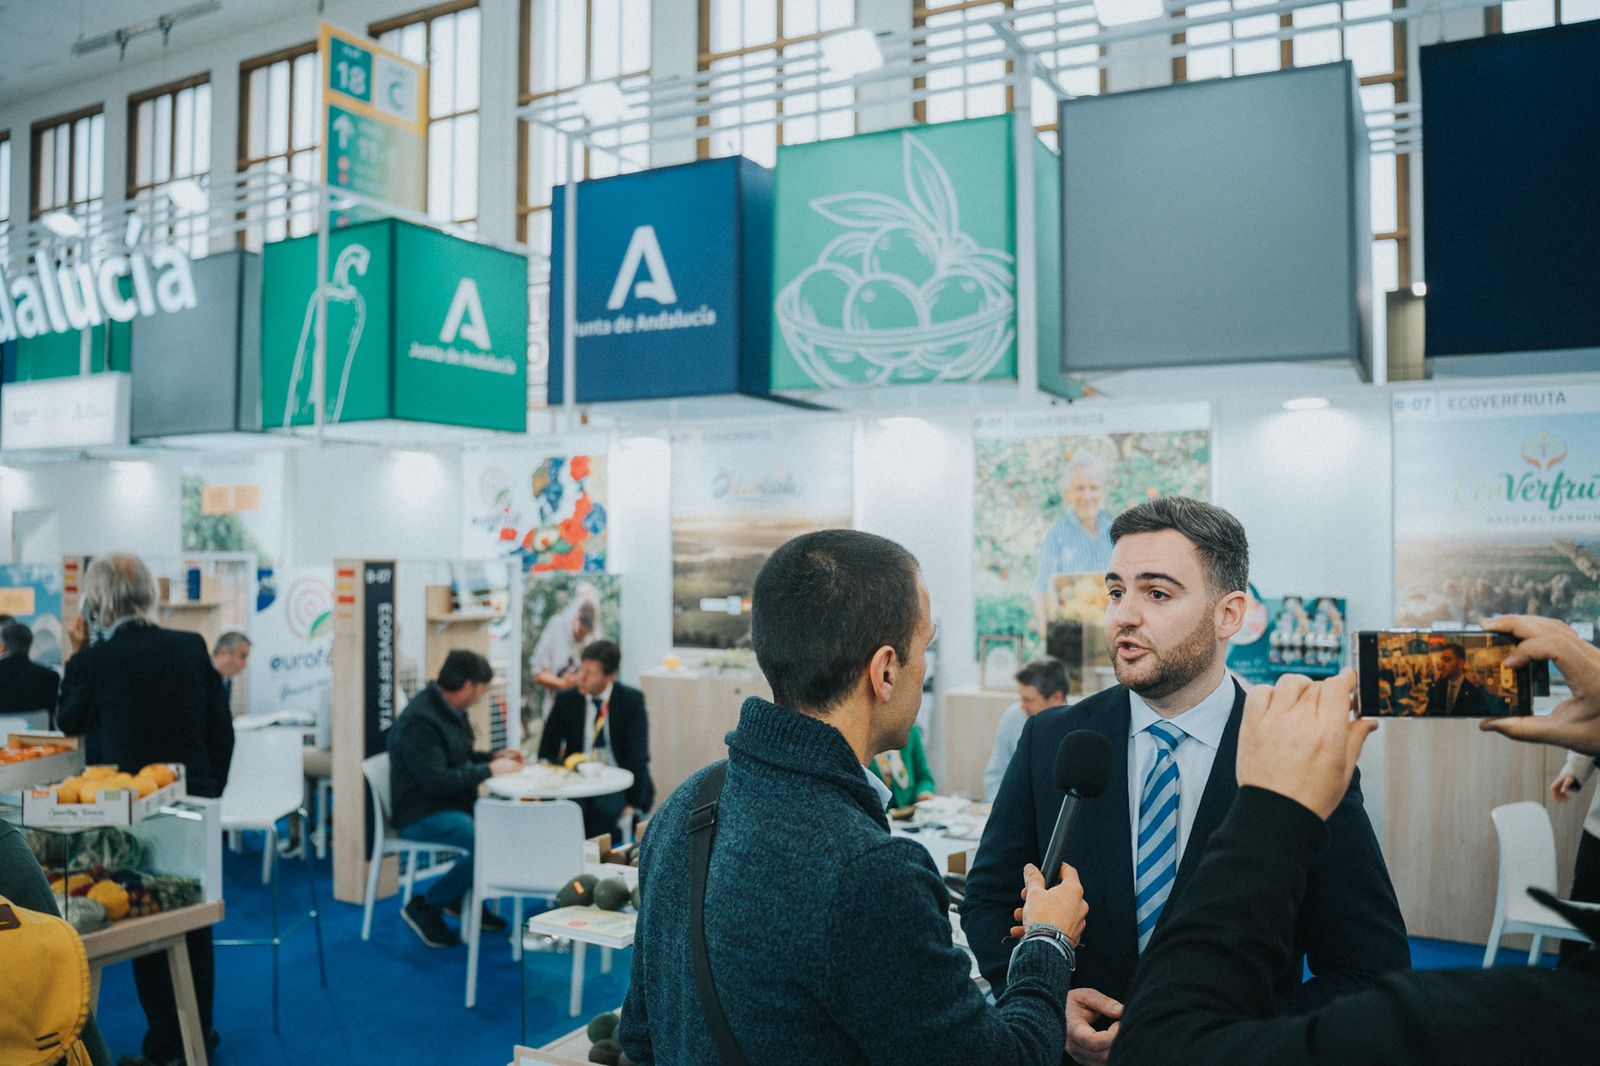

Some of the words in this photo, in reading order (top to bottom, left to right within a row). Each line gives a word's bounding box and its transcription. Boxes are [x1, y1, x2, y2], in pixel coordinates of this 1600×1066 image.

[336, 60, 367, 96] 18
[387, 80, 404, 111] C
[613, 313, 635, 335] de
[635, 304, 717, 333] Andalucía
[1447, 389, 1567, 411] ECOVERFRUTA
[365, 568, 392, 585] B-07
[377, 602, 393, 732] ECOVERFRUTA
